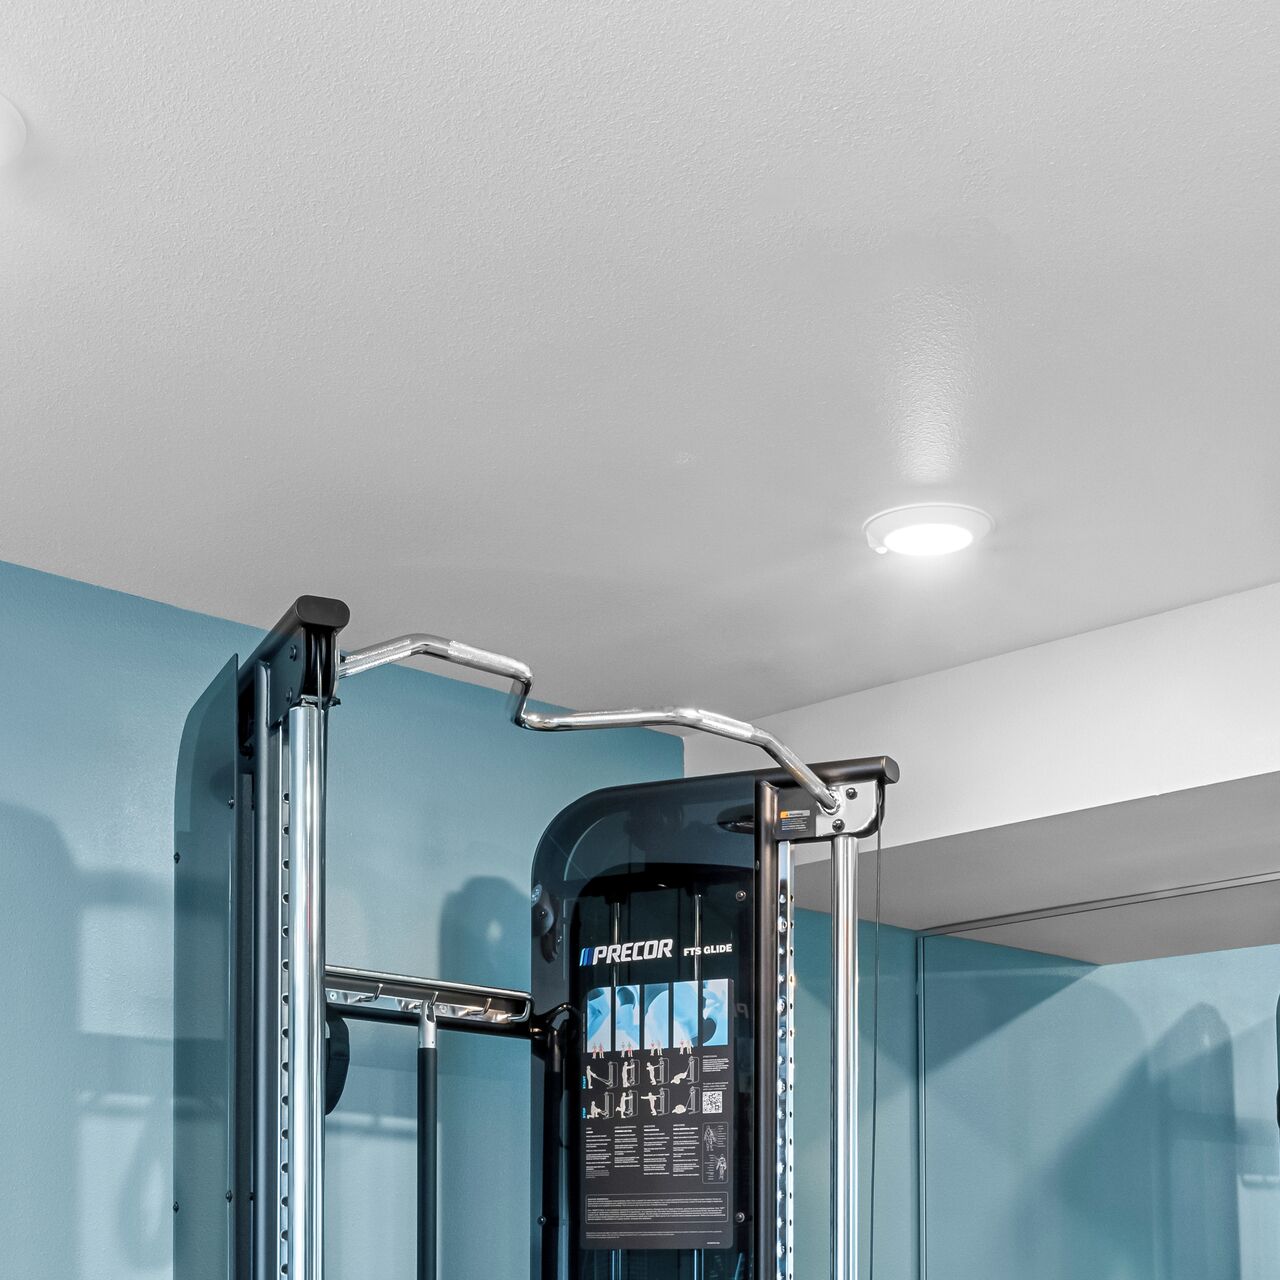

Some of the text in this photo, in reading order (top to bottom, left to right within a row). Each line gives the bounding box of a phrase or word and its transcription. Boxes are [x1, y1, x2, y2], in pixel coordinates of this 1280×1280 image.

[592, 939, 673, 966] PRECOR
[683, 944, 733, 957] FTS GLIDE
